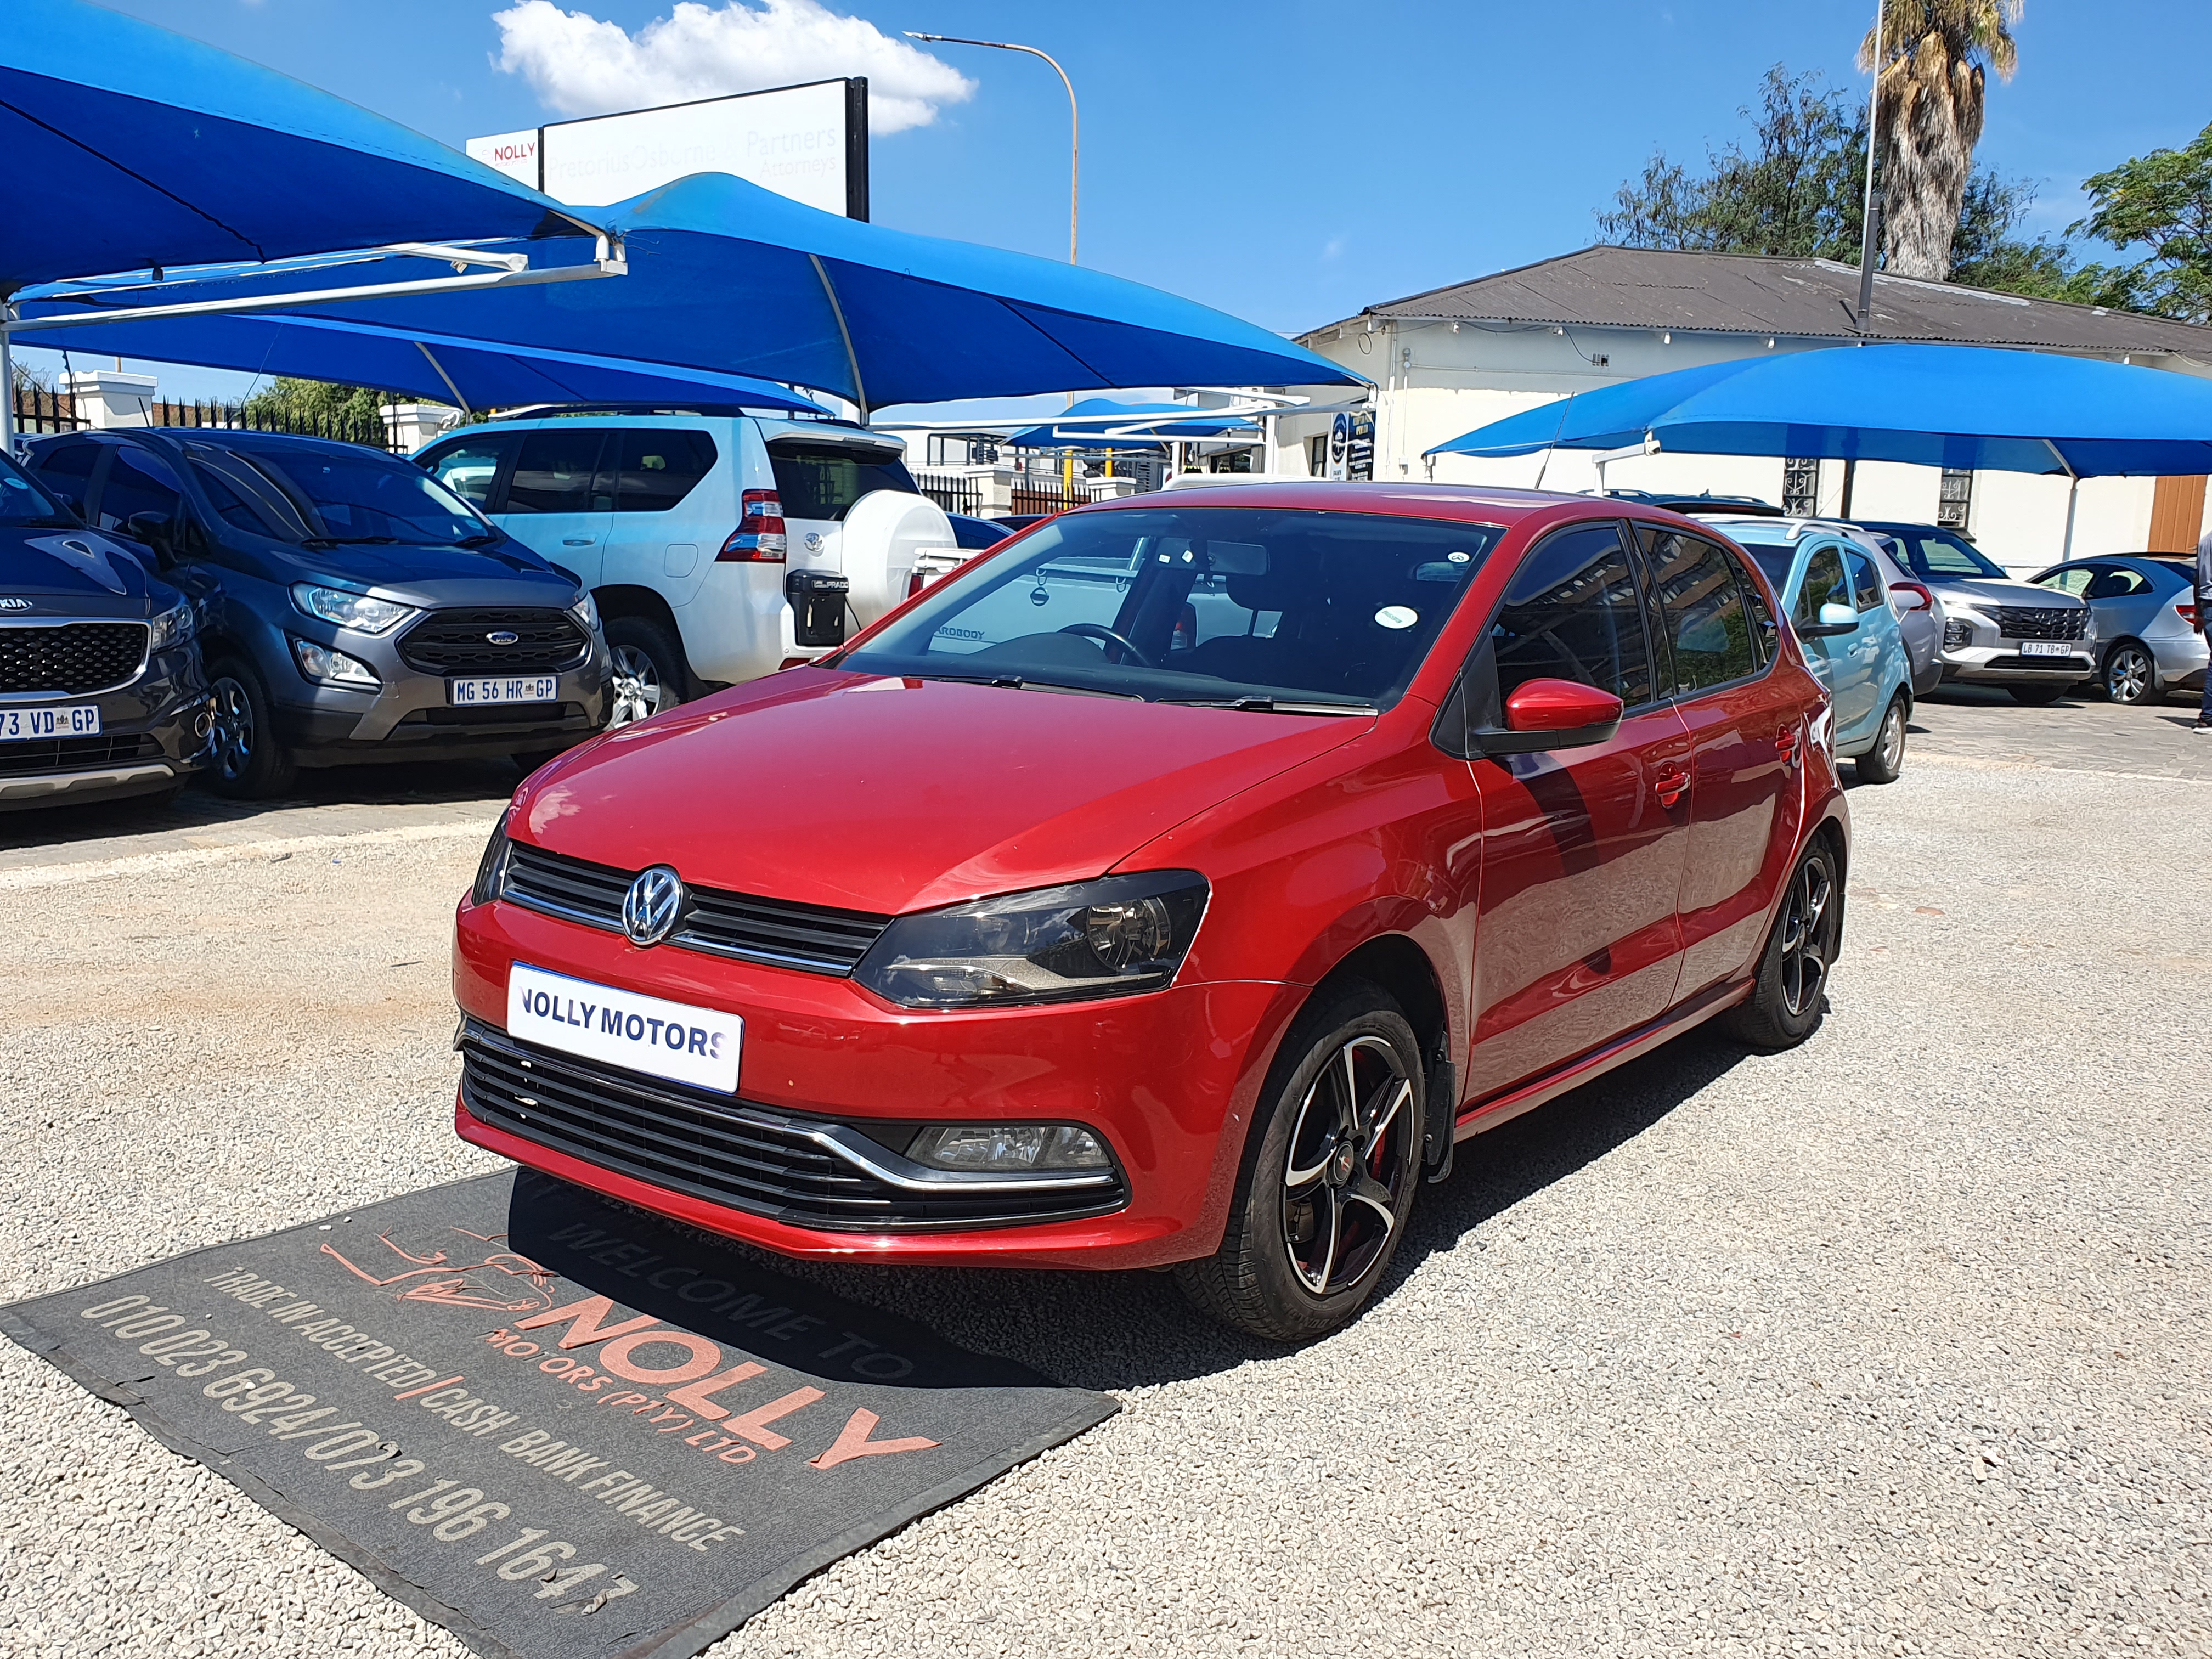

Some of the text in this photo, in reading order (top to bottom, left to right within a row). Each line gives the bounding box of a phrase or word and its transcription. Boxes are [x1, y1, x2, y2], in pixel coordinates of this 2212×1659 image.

[495, 142, 535, 162] NOLLY
[747, 127, 836, 157] Partners
[759, 155, 837, 178] Attorneys
[0, 598, 27, 608] KIA
[2023, 644, 2069, 654] LB 71 TB GP
[457, 679, 553, 702] MG 56 HR GP
[30, 712, 55, 734] VD
[72, 709, 94, 731] GP
[519, 986, 727, 1059] NOLLY MOTORS
[548, 1223, 915, 1379] WELCOME TO
[512, 1295, 943, 1470] NOLLY
[81, 1295, 186, 1339] 010
[139, 1329, 248, 1377] 023
[388, 1477, 511, 1542] 196
[202, 1268, 747, 1553] TRADE IN ACCEPTED CASH BANK FINANCE
[597, 1391, 694, 1432] (PTY)
[684, 1430, 757, 1464] LTD
